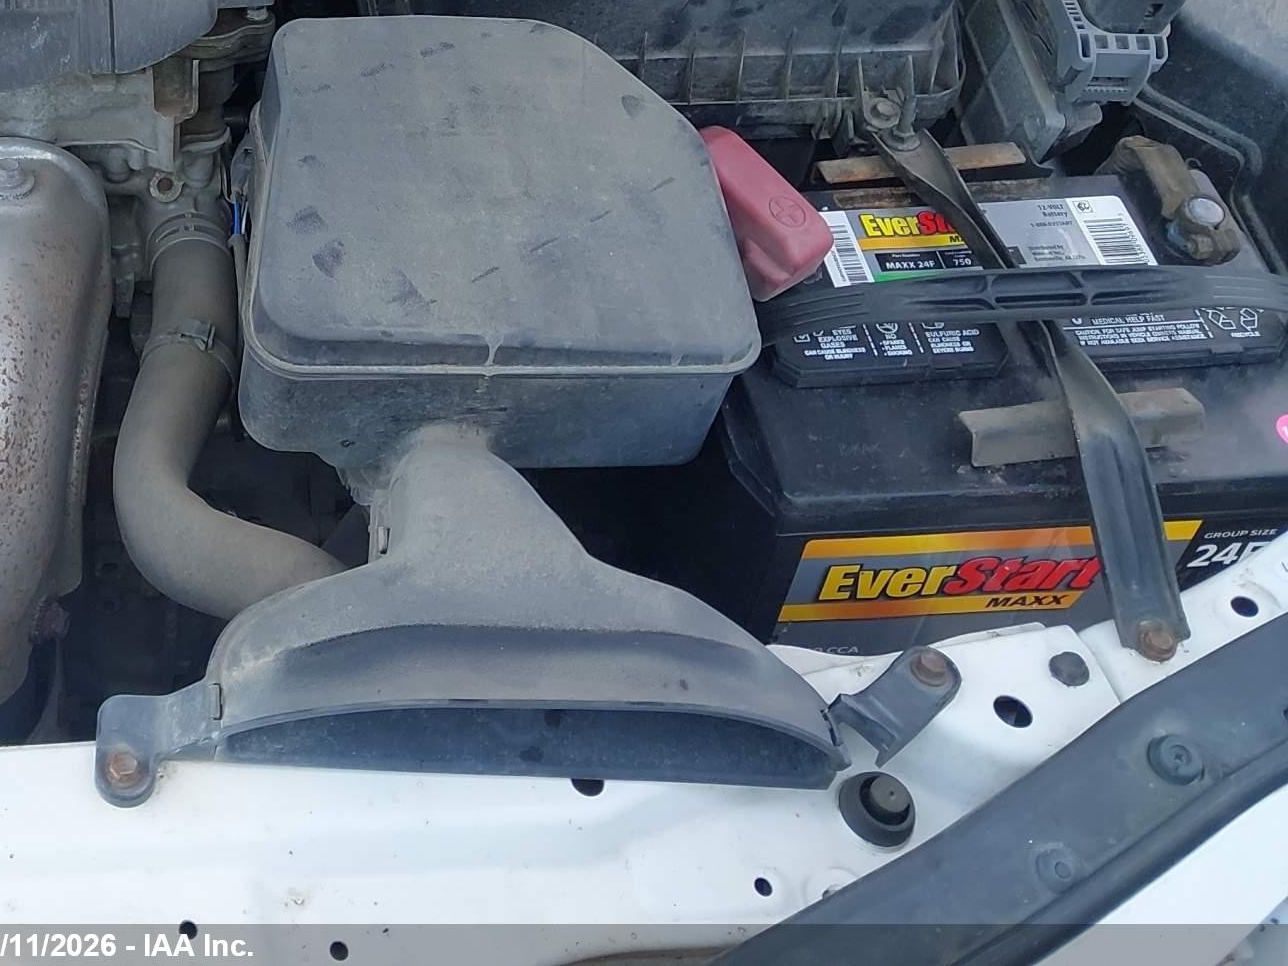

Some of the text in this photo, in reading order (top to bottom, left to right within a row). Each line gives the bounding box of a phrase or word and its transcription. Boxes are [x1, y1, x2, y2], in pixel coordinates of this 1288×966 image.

[885, 260, 936, 270] MAXX 24F
[952, 258, 972, 266] 750
[1091, 317, 1126, 325] MEDICAL
[1126, 315, 1146, 323] HELP
[832, 328, 852, 336] EYES
[820, 341, 846, 349] GASES
[1203, 528, 1279, 539] GROUP SIZE
[818, 555, 1102, 602] EverStart
[984, 593, 1069, 609] MAXX
